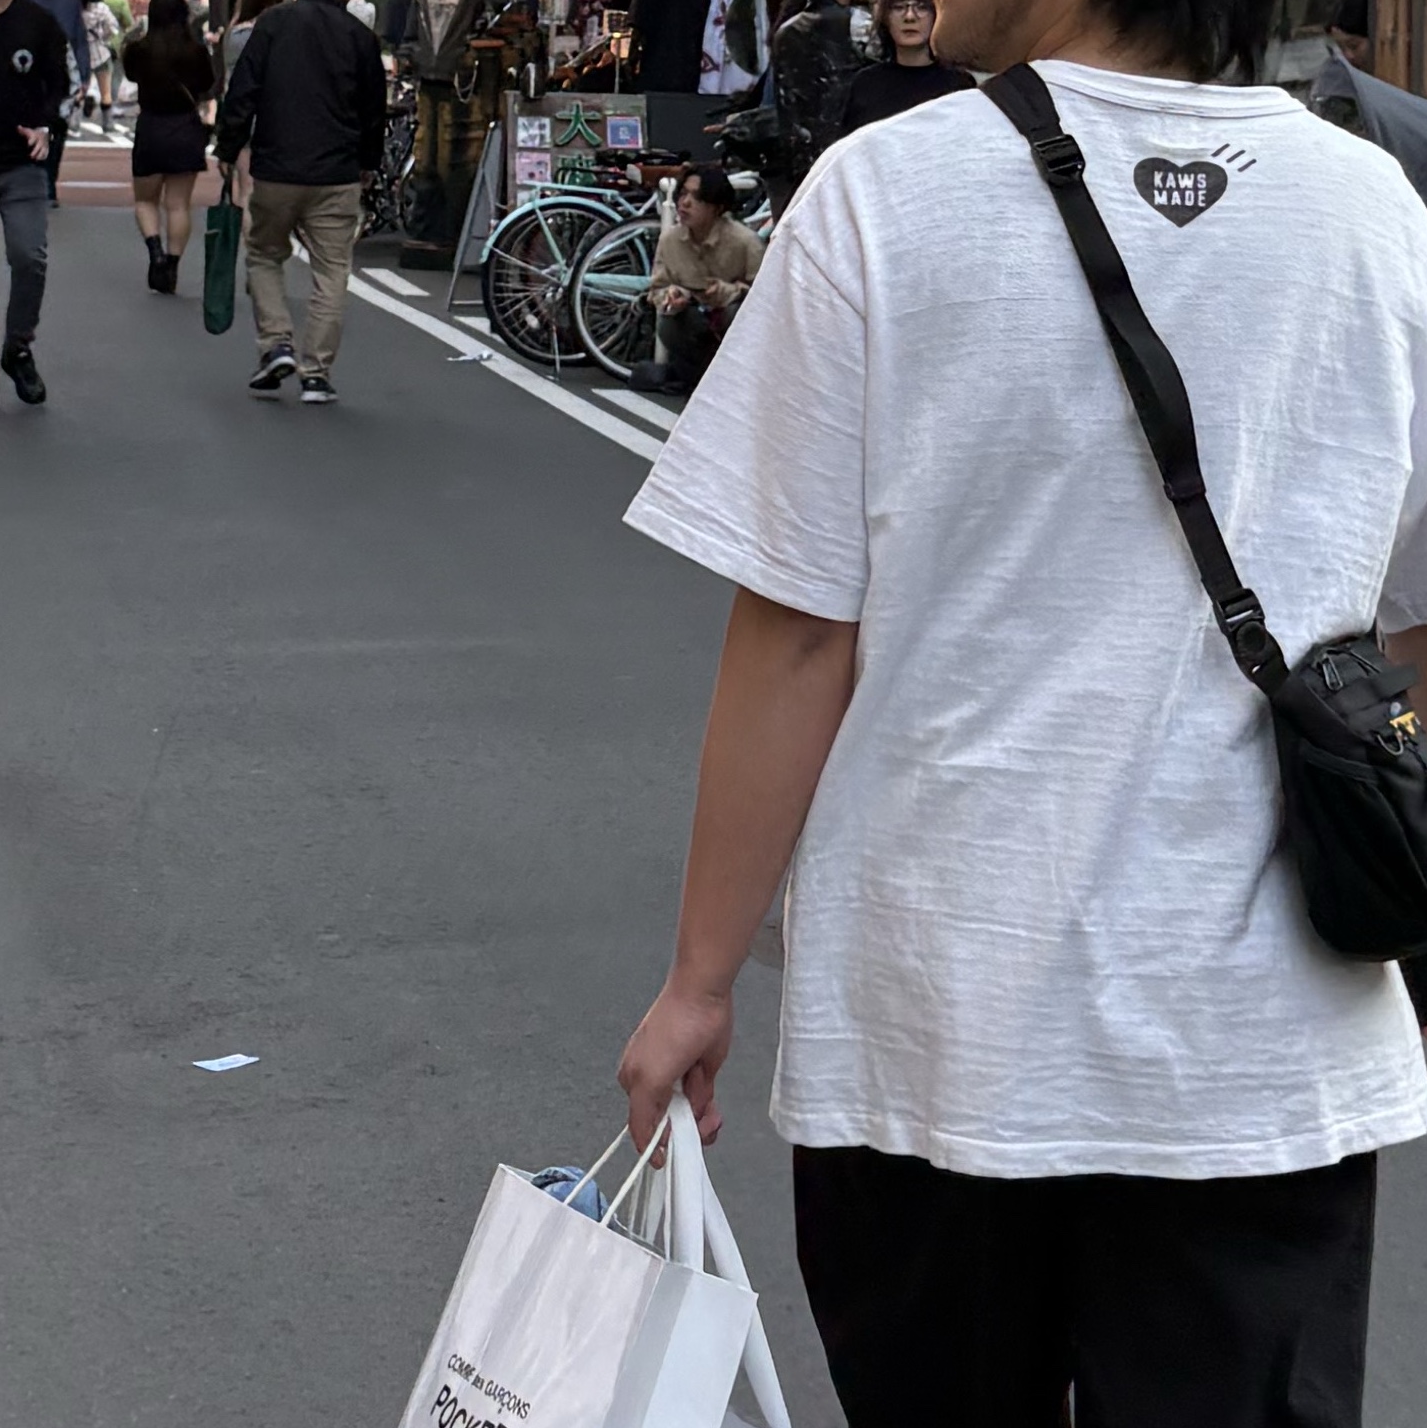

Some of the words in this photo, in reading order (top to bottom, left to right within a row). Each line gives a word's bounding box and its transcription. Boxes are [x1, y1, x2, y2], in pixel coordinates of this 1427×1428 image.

[1153, 171, 1207, 190] KAWS
[1153, 189, 1207, 208] MADE
[484, 1379, 532, 1420] GARÇONS
